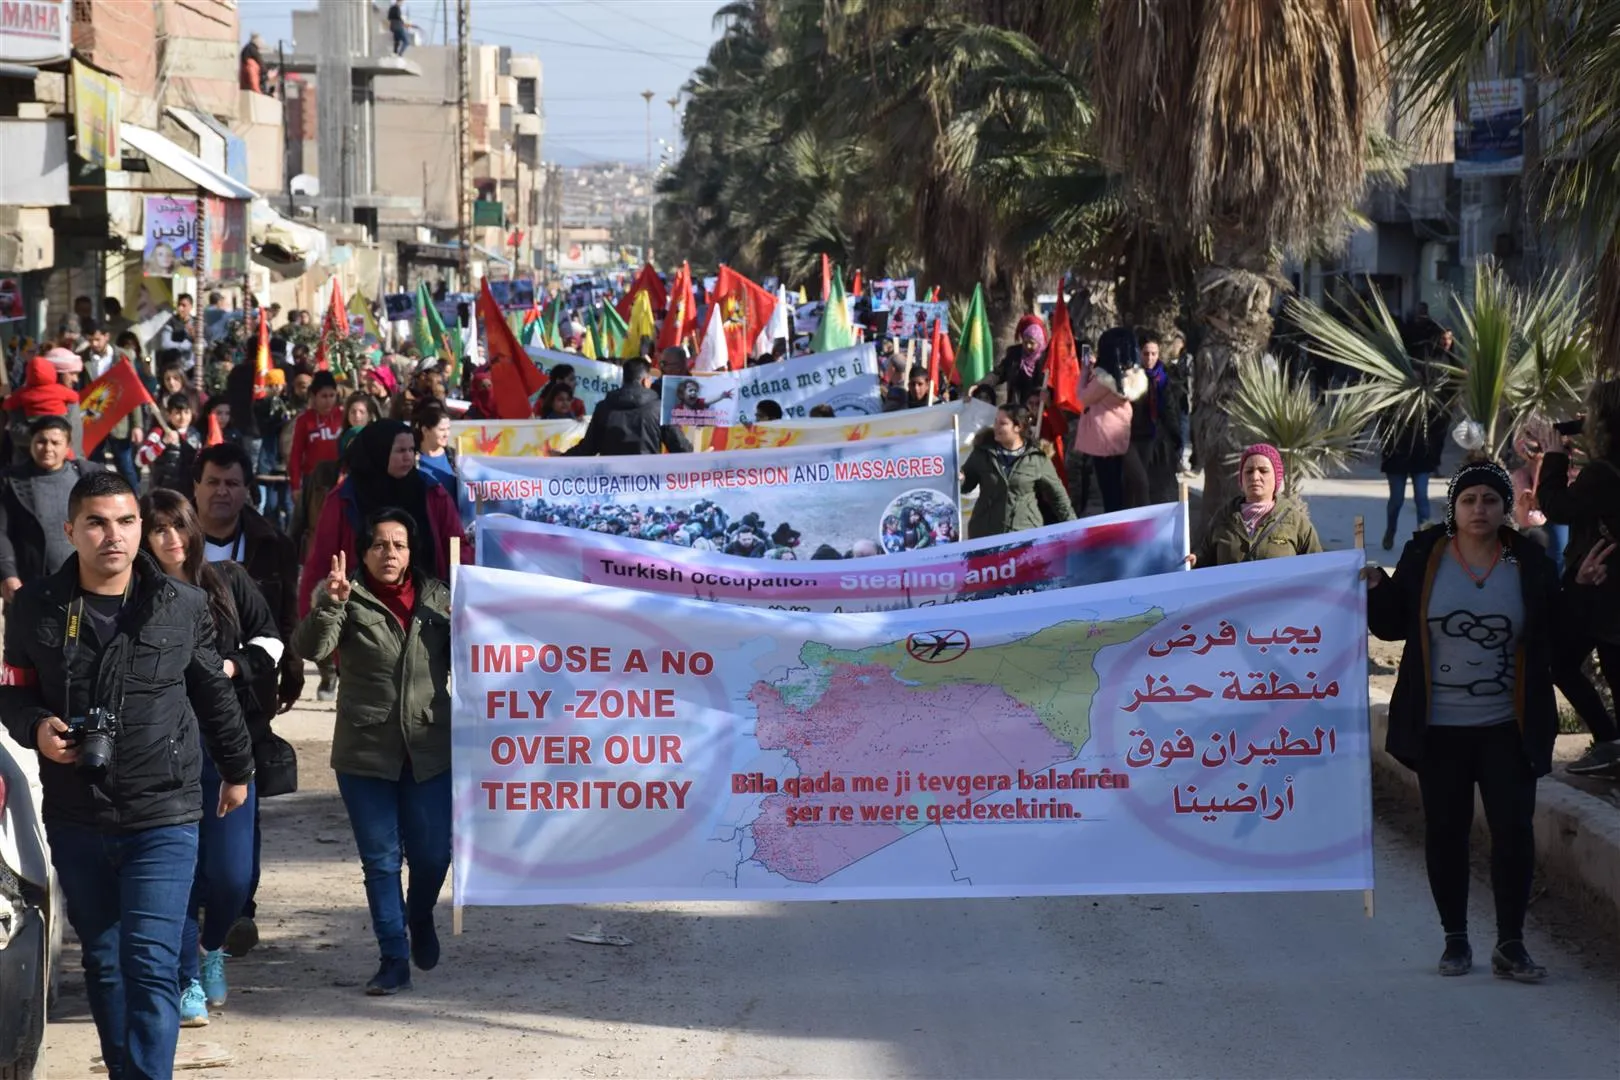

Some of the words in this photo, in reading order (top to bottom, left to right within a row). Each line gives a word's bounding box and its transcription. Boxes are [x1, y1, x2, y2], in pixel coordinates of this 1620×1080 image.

[796, 370, 821, 388] me
[826, 364, 846, 387] ye
[465, 480, 543, 501] TURKISH
[549, 474, 660, 497] OCCUPATION
[666, 466, 788, 490] SUPPRESSION
[793, 464, 830, 482] AND
[834, 456, 944, 481] MASSACRES
[600, 560, 683, 583] Turkish
[965, 559, 1016, 585] and
[69, 615, 78, 637] Nikon
[1148, 620, 1237, 657] فرض
[1246, 624, 1322, 655] يجب
[470, 644, 612, 674] IMPOSE
[622, 649, 649, 673] A
[661, 650, 714, 677] NO
[1120, 673, 1215, 712] حظر
[1221, 670, 1340, 701] منطقة
[486, 690, 553, 719] FLY
[563, 689, 676, 719] -ZONE
[490, 736, 592, 765] OVER
[603, 735, 683, 764] OUR
[1124, 728, 1196, 768] فوق
[1201, 725, 1336, 767] الطيران
[481, 781, 693, 811] TERRITORY
[731, 772, 778, 794] Bila
[783, 770, 846, 798] qada
[852, 776, 889, 792] me
[894, 770, 911, 797] ji
[918, 772, 1012, 796] tevgera
[1172, 775, 1295, 822] أراضينا
[785, 803, 824, 828] şer
[829, 804, 854, 821] re
[860, 803, 919, 821] were
[926, 798, 1082, 826] qedexekirin.
